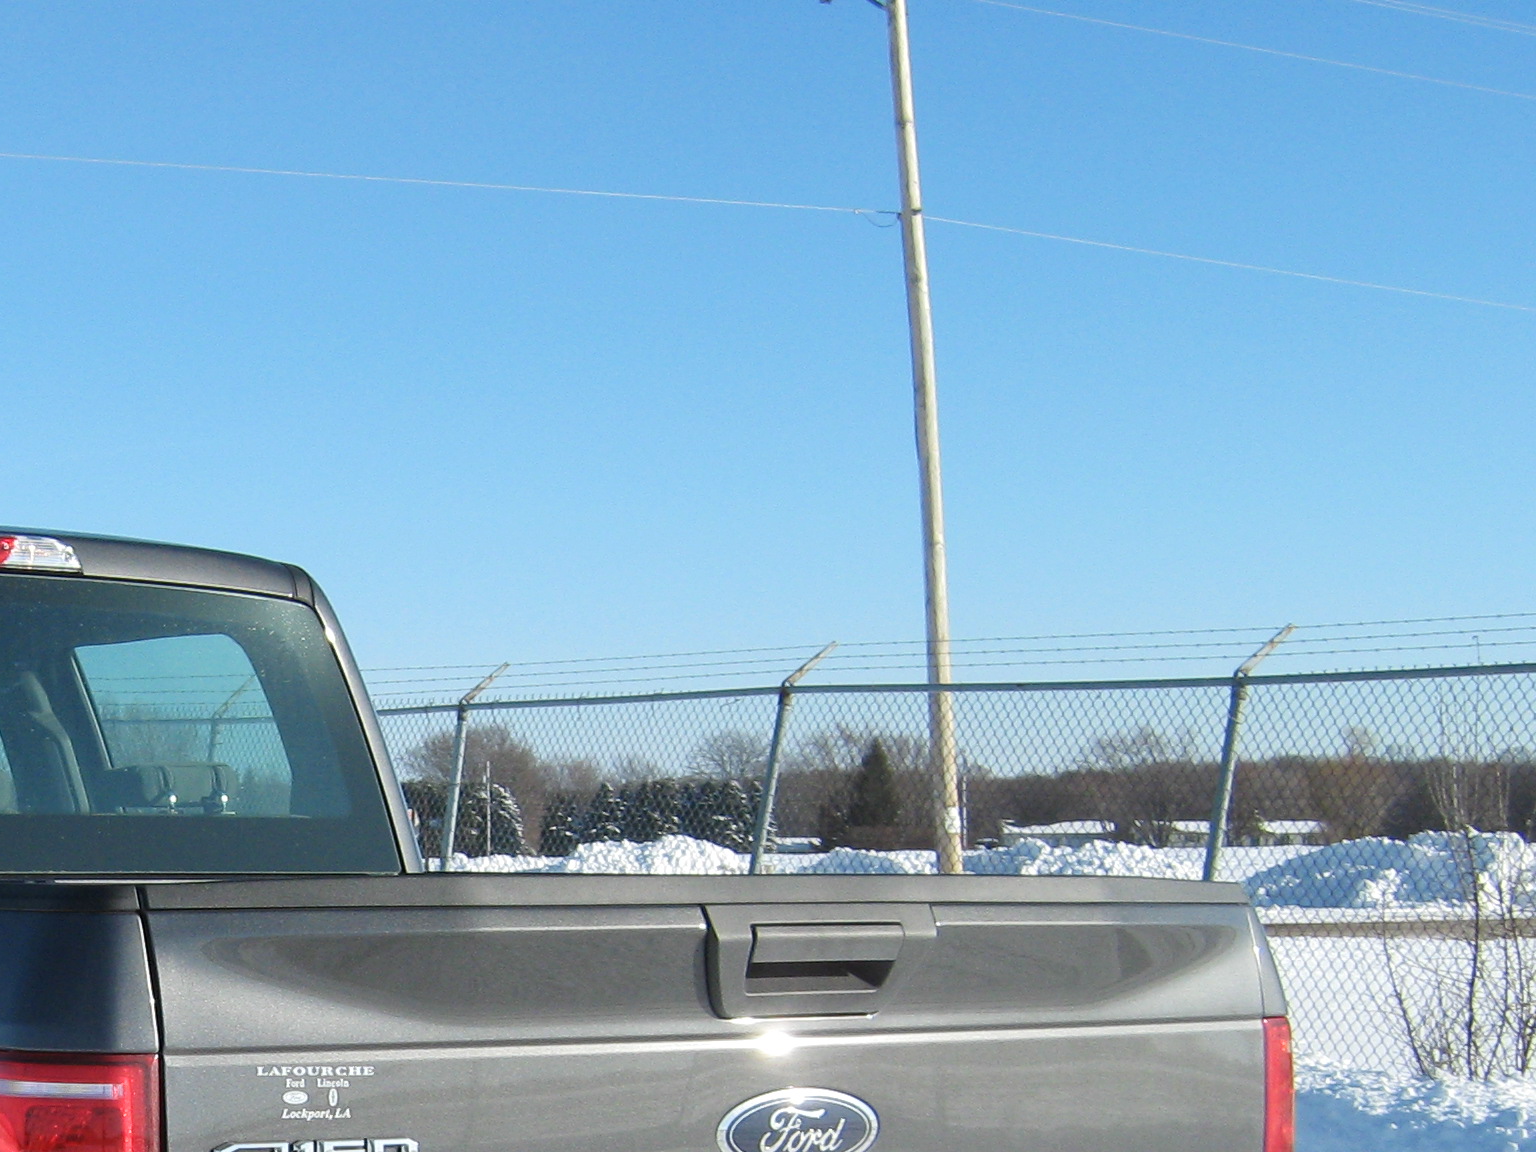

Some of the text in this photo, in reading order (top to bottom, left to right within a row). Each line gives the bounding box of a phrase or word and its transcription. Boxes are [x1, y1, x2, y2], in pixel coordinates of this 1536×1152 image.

[256, 1066, 375, 1077] LAFOURCHE
[285, 1078, 350, 1088] Ford Lincoln
[281, 1108, 352, 1121] Lockport, LA
